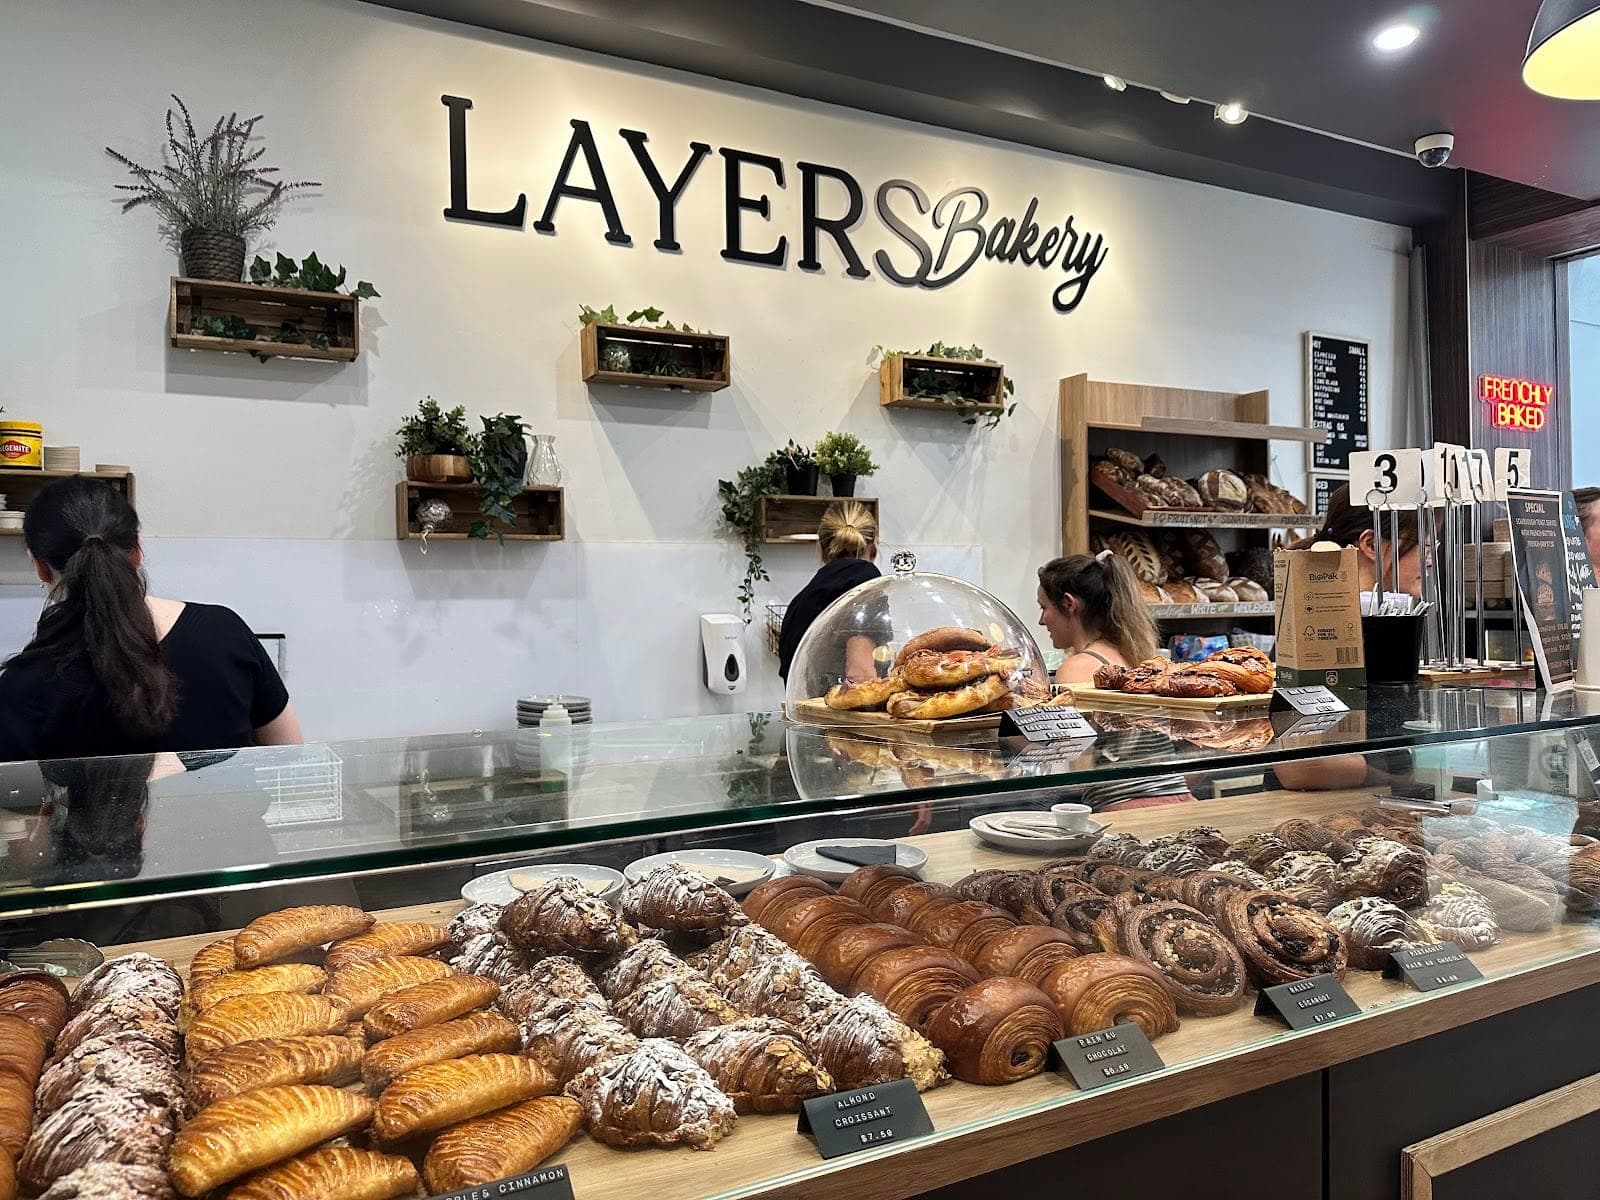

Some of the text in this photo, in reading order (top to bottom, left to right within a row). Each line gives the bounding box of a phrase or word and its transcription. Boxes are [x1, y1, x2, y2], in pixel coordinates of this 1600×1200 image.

[441, 94, 1109, 312] LAYERS Bakery
[1484, 376, 1553, 406] FRENCHLY
[1497, 402, 1544, 429] BAKED
[1374, 454, 1398, 493] 3
[1507, 451, 1518, 488] 5
[1524, 502, 1545, 513] SPECIAL
[1309, 572, 1338, 580] BioPak
[1190, 603, 1217, 615] WHITE
[1079, 1031, 1116, 1047] PAIN AU
[1087, 1045, 1126, 1060] CHOCOLAT
[838, 1092, 876, 1108] ALMOND
[835, 1106, 892, 1127] CROISSANT
[861, 1129, 893, 1143] $7.50
[499, 1168, 564, 1194] CINNAMON
